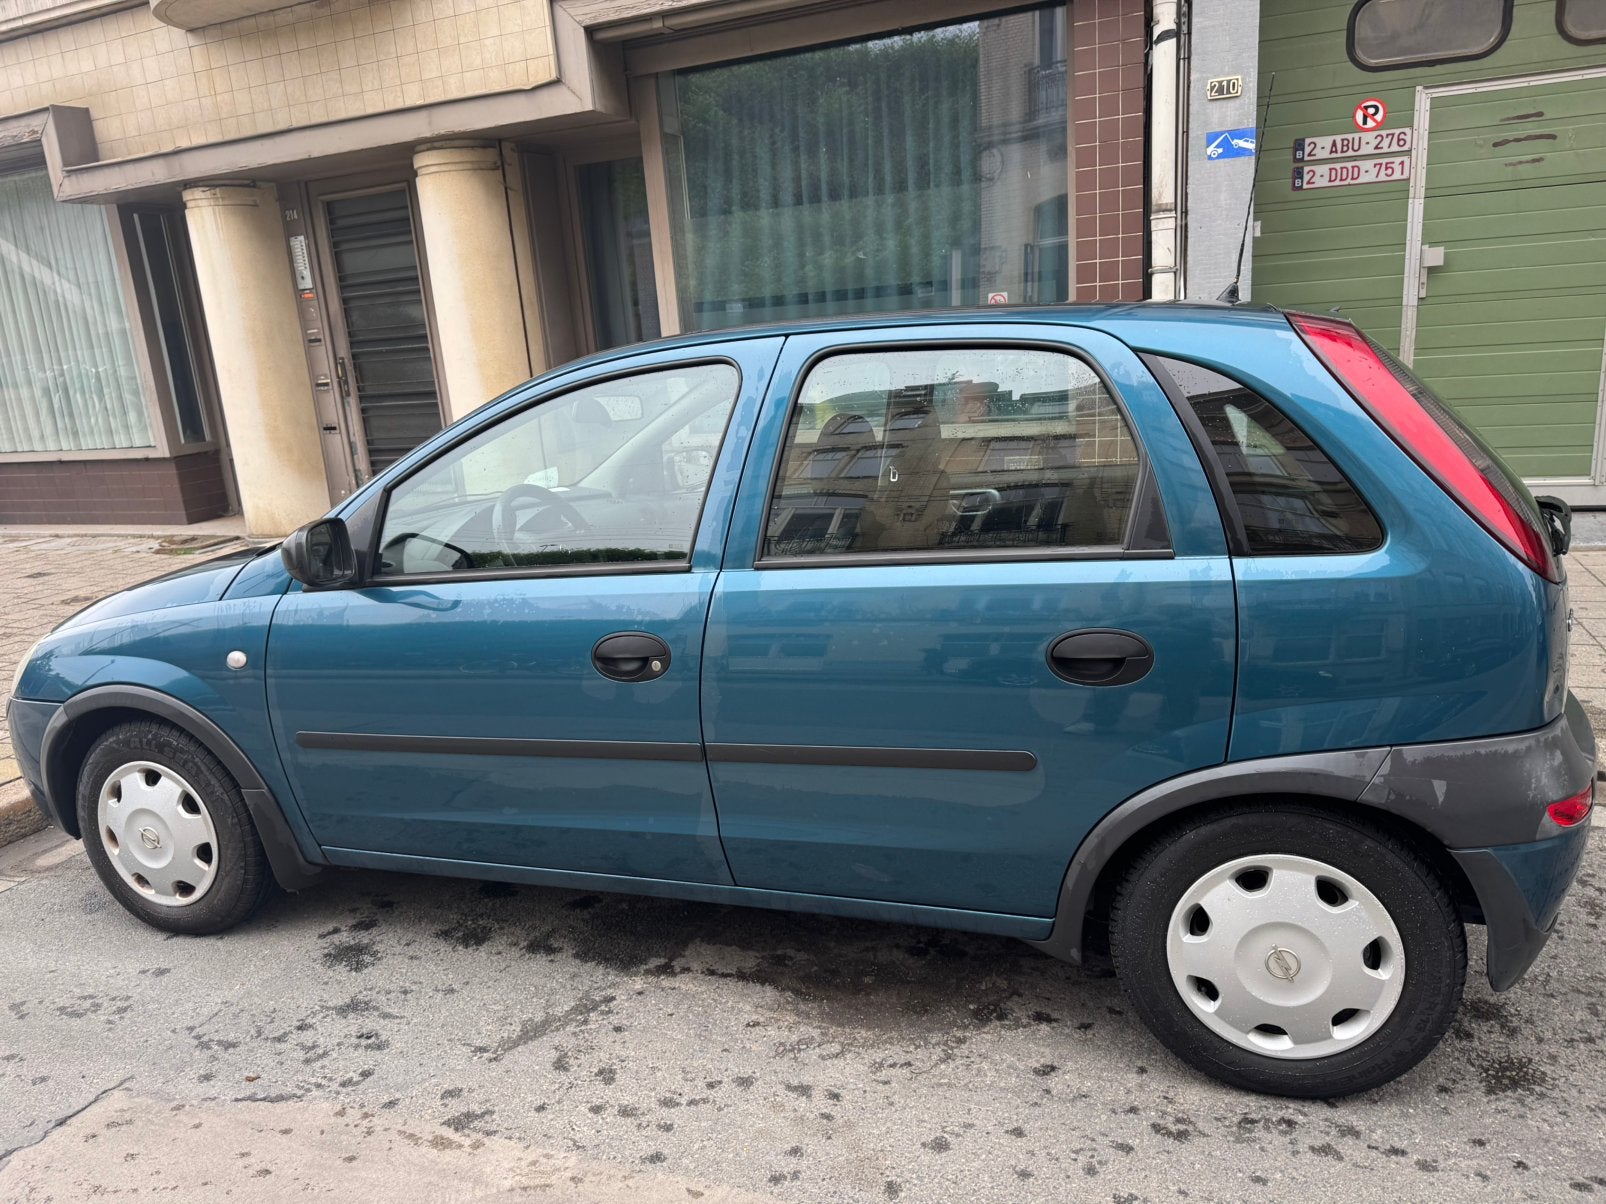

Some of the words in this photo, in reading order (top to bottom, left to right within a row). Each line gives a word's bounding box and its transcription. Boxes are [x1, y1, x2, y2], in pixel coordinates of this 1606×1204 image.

[1210, 79, 1238, 96] 210
[1362, 104, 1380, 126] P
[1296, 150, 1303, 159] B
[1306, 131, 1408, 158] 2-ABU-276
[1294, 178, 1302, 187] B
[1305, 160, 1406, 185] 2-DDD-751
[285, 209, 298, 221] 214
